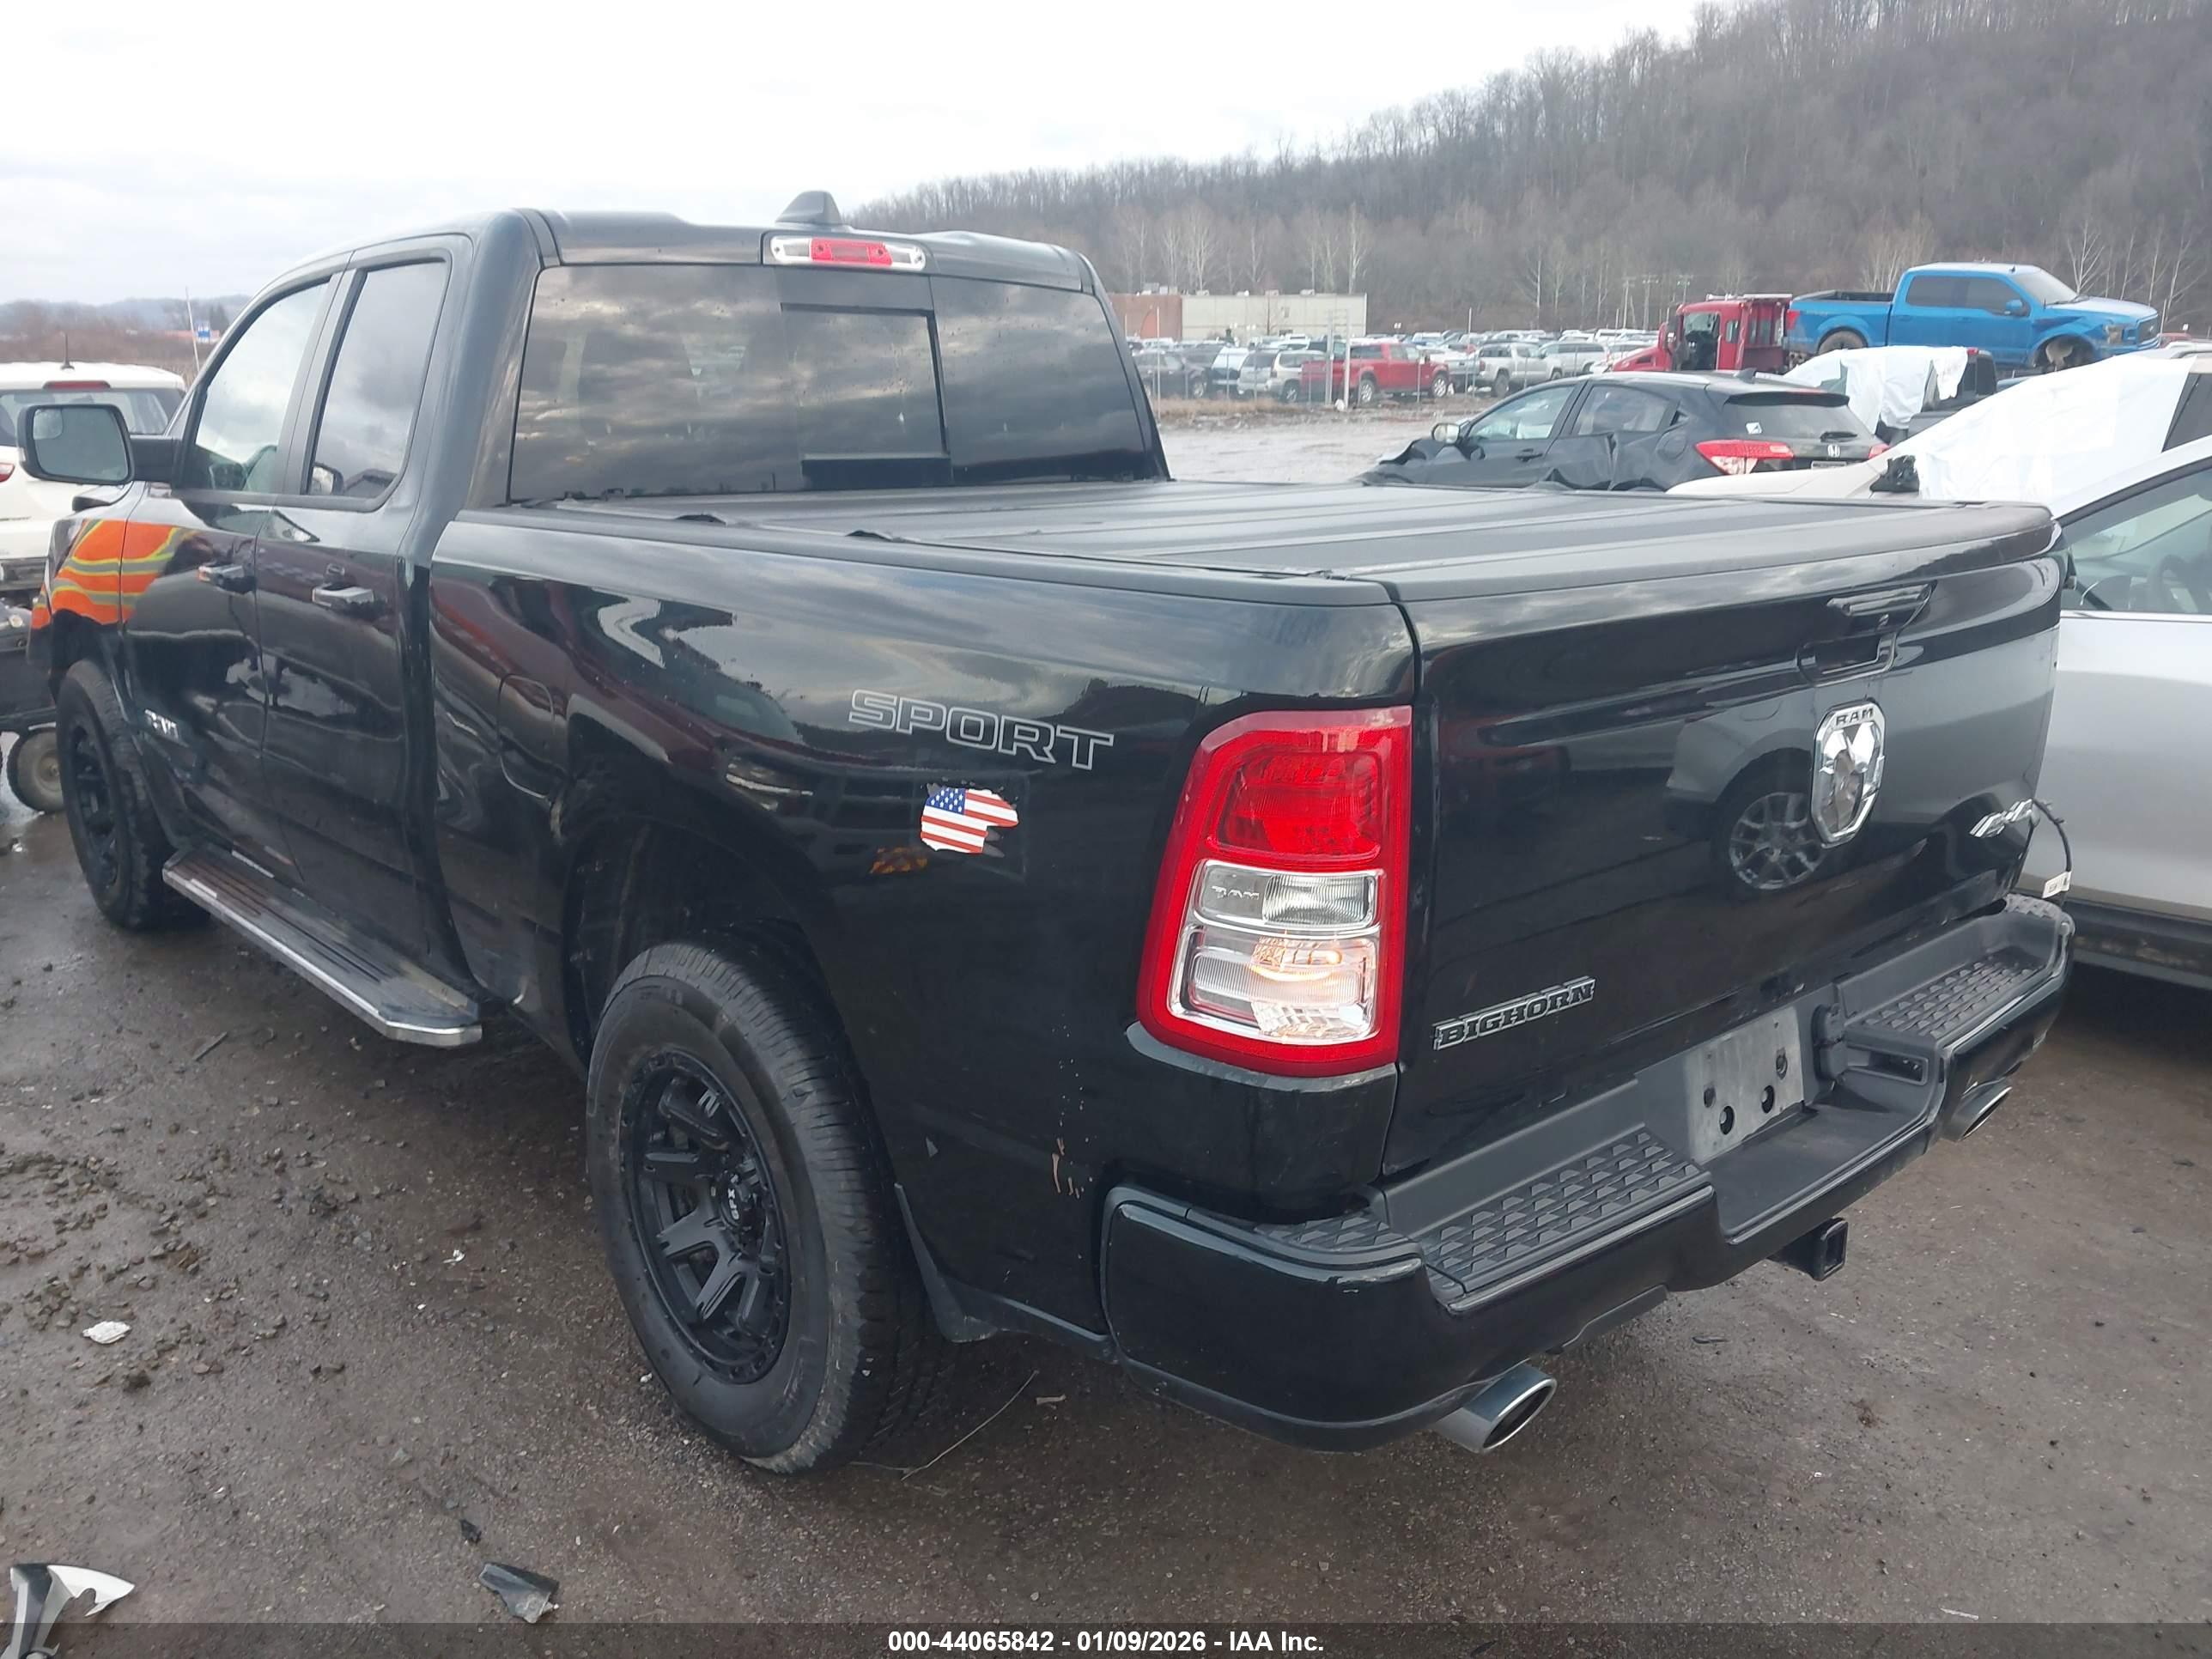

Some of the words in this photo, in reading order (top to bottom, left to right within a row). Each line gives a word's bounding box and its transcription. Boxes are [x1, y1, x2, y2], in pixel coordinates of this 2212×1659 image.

[848, 689, 1115, 770] SPORT
[1836, 708, 1874, 726] RAM
[1433, 976, 1596, 1050] BIGHORN
